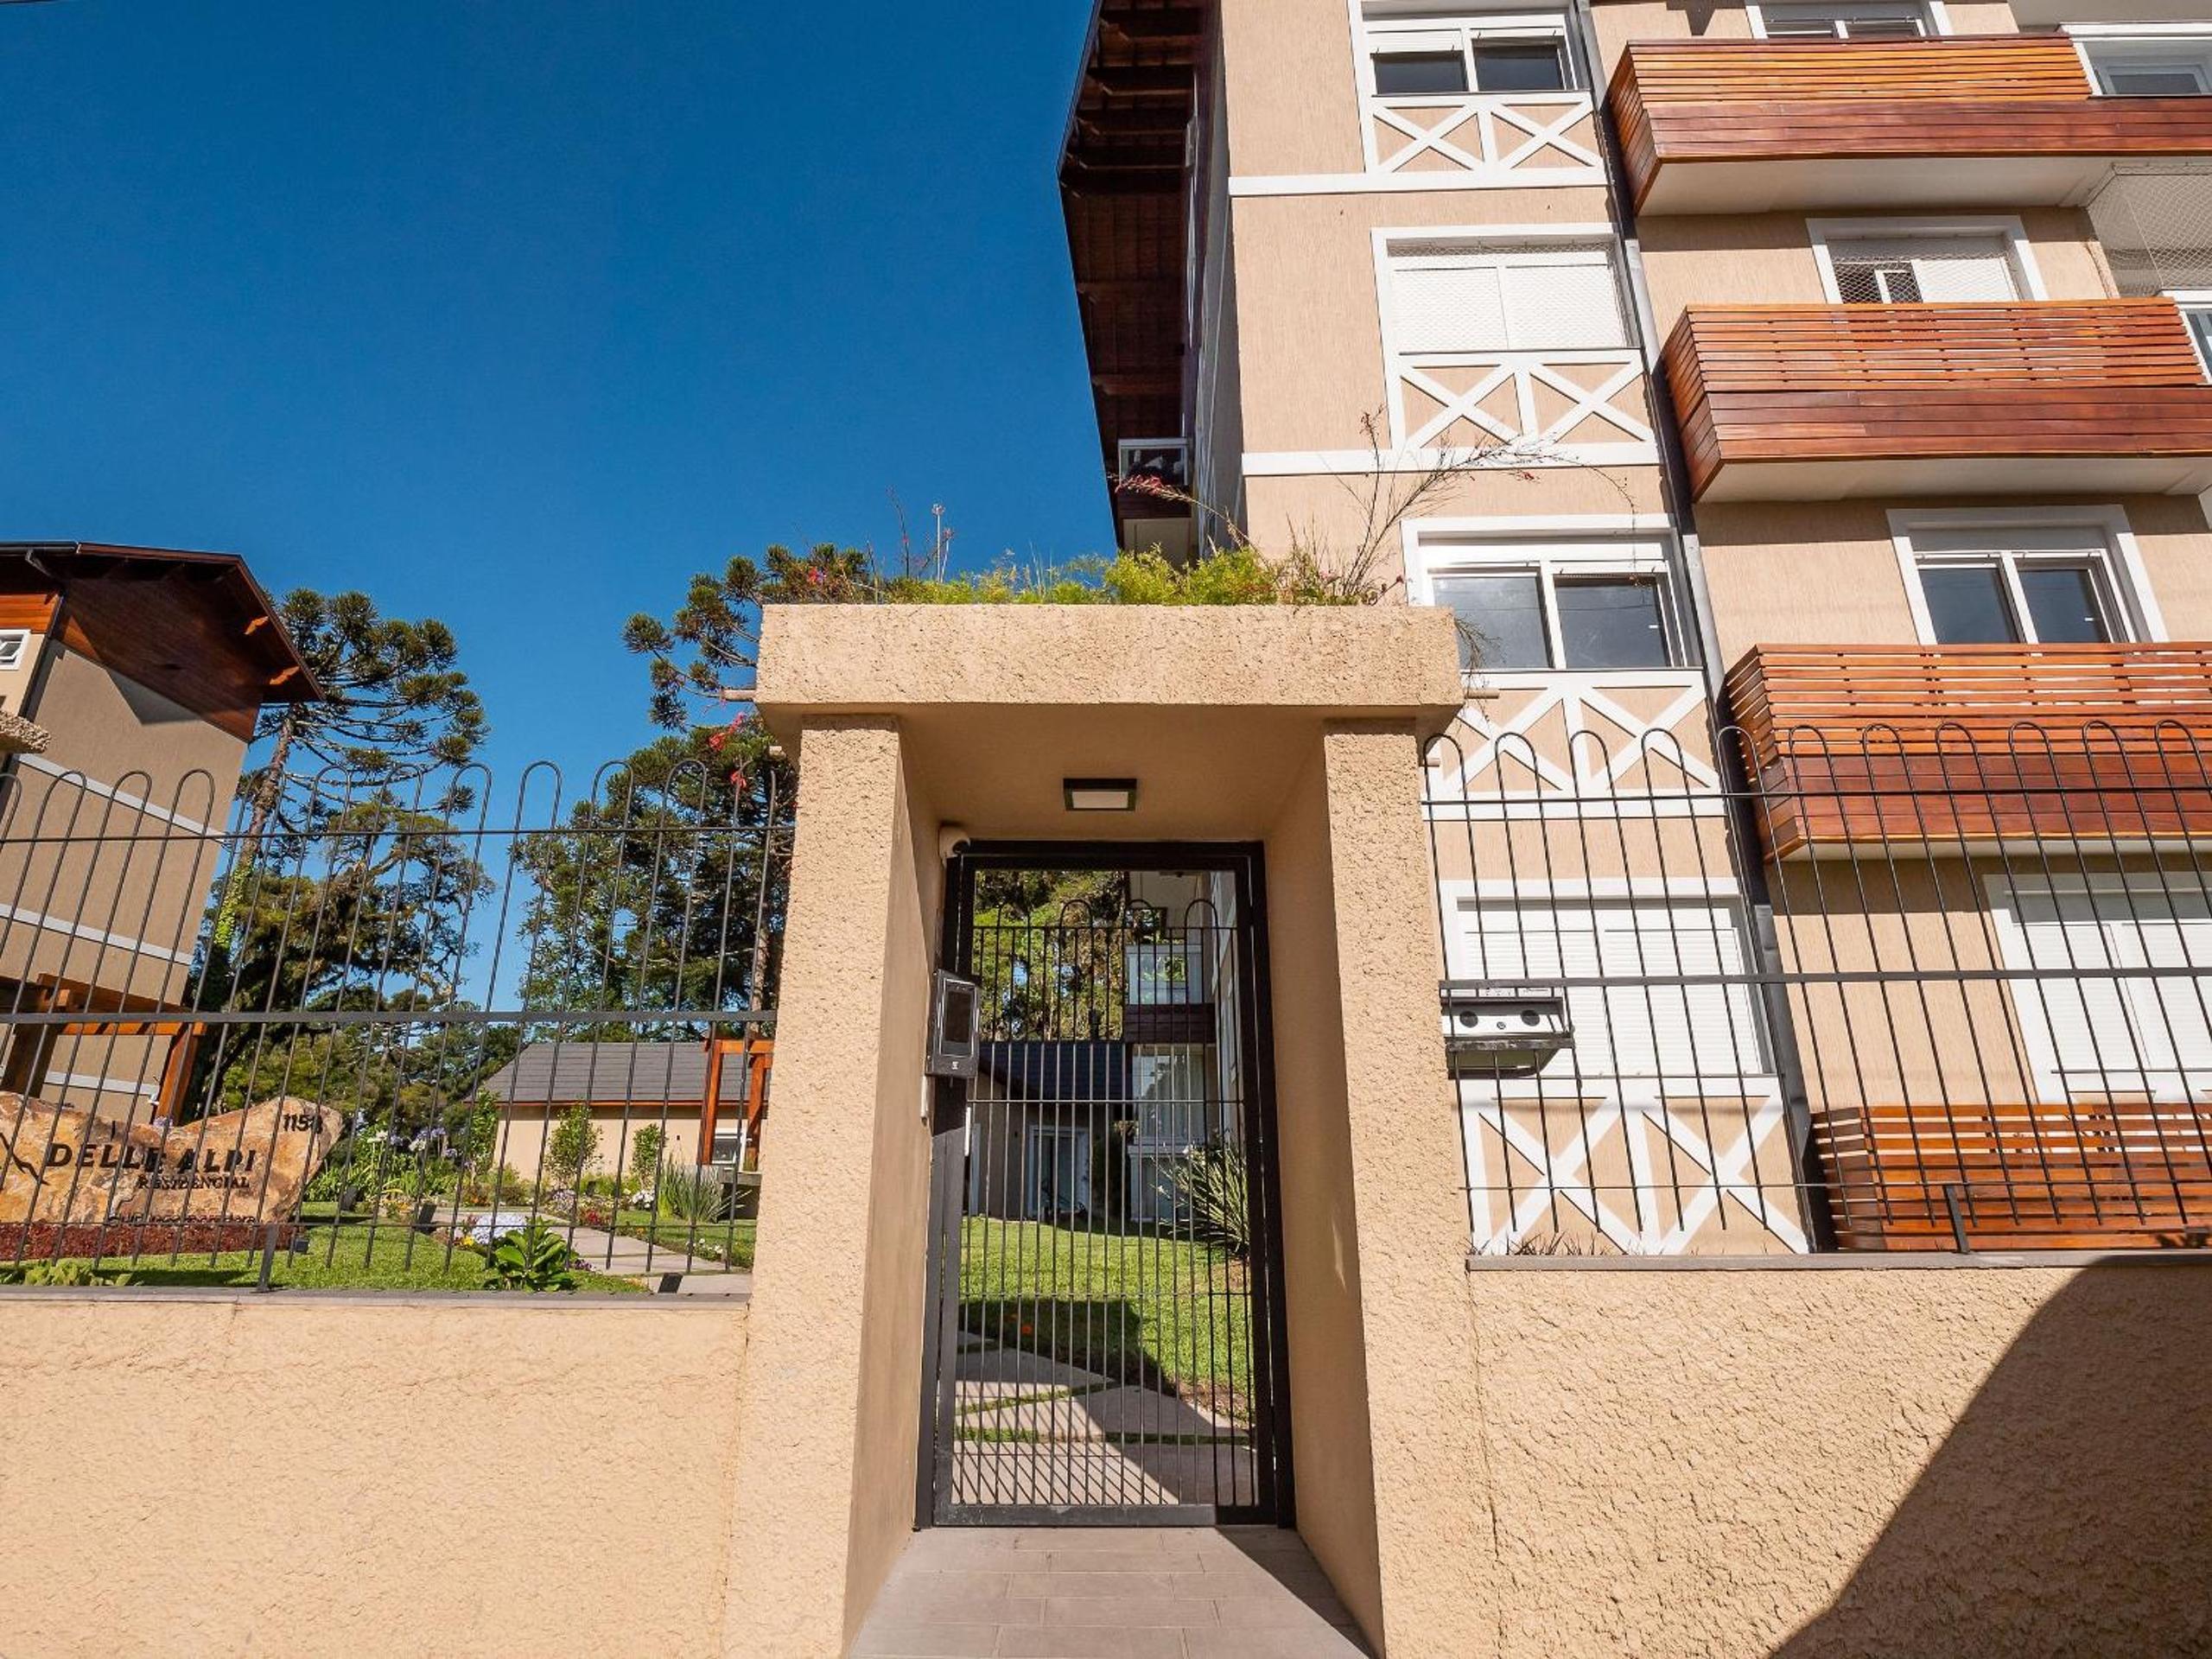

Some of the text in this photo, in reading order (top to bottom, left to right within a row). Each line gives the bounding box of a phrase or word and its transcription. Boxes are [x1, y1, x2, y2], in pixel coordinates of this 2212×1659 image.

[46, 1142, 257, 1173] DELLE ALPI
[137, 1173, 250, 1190] RESIDENCIAL
